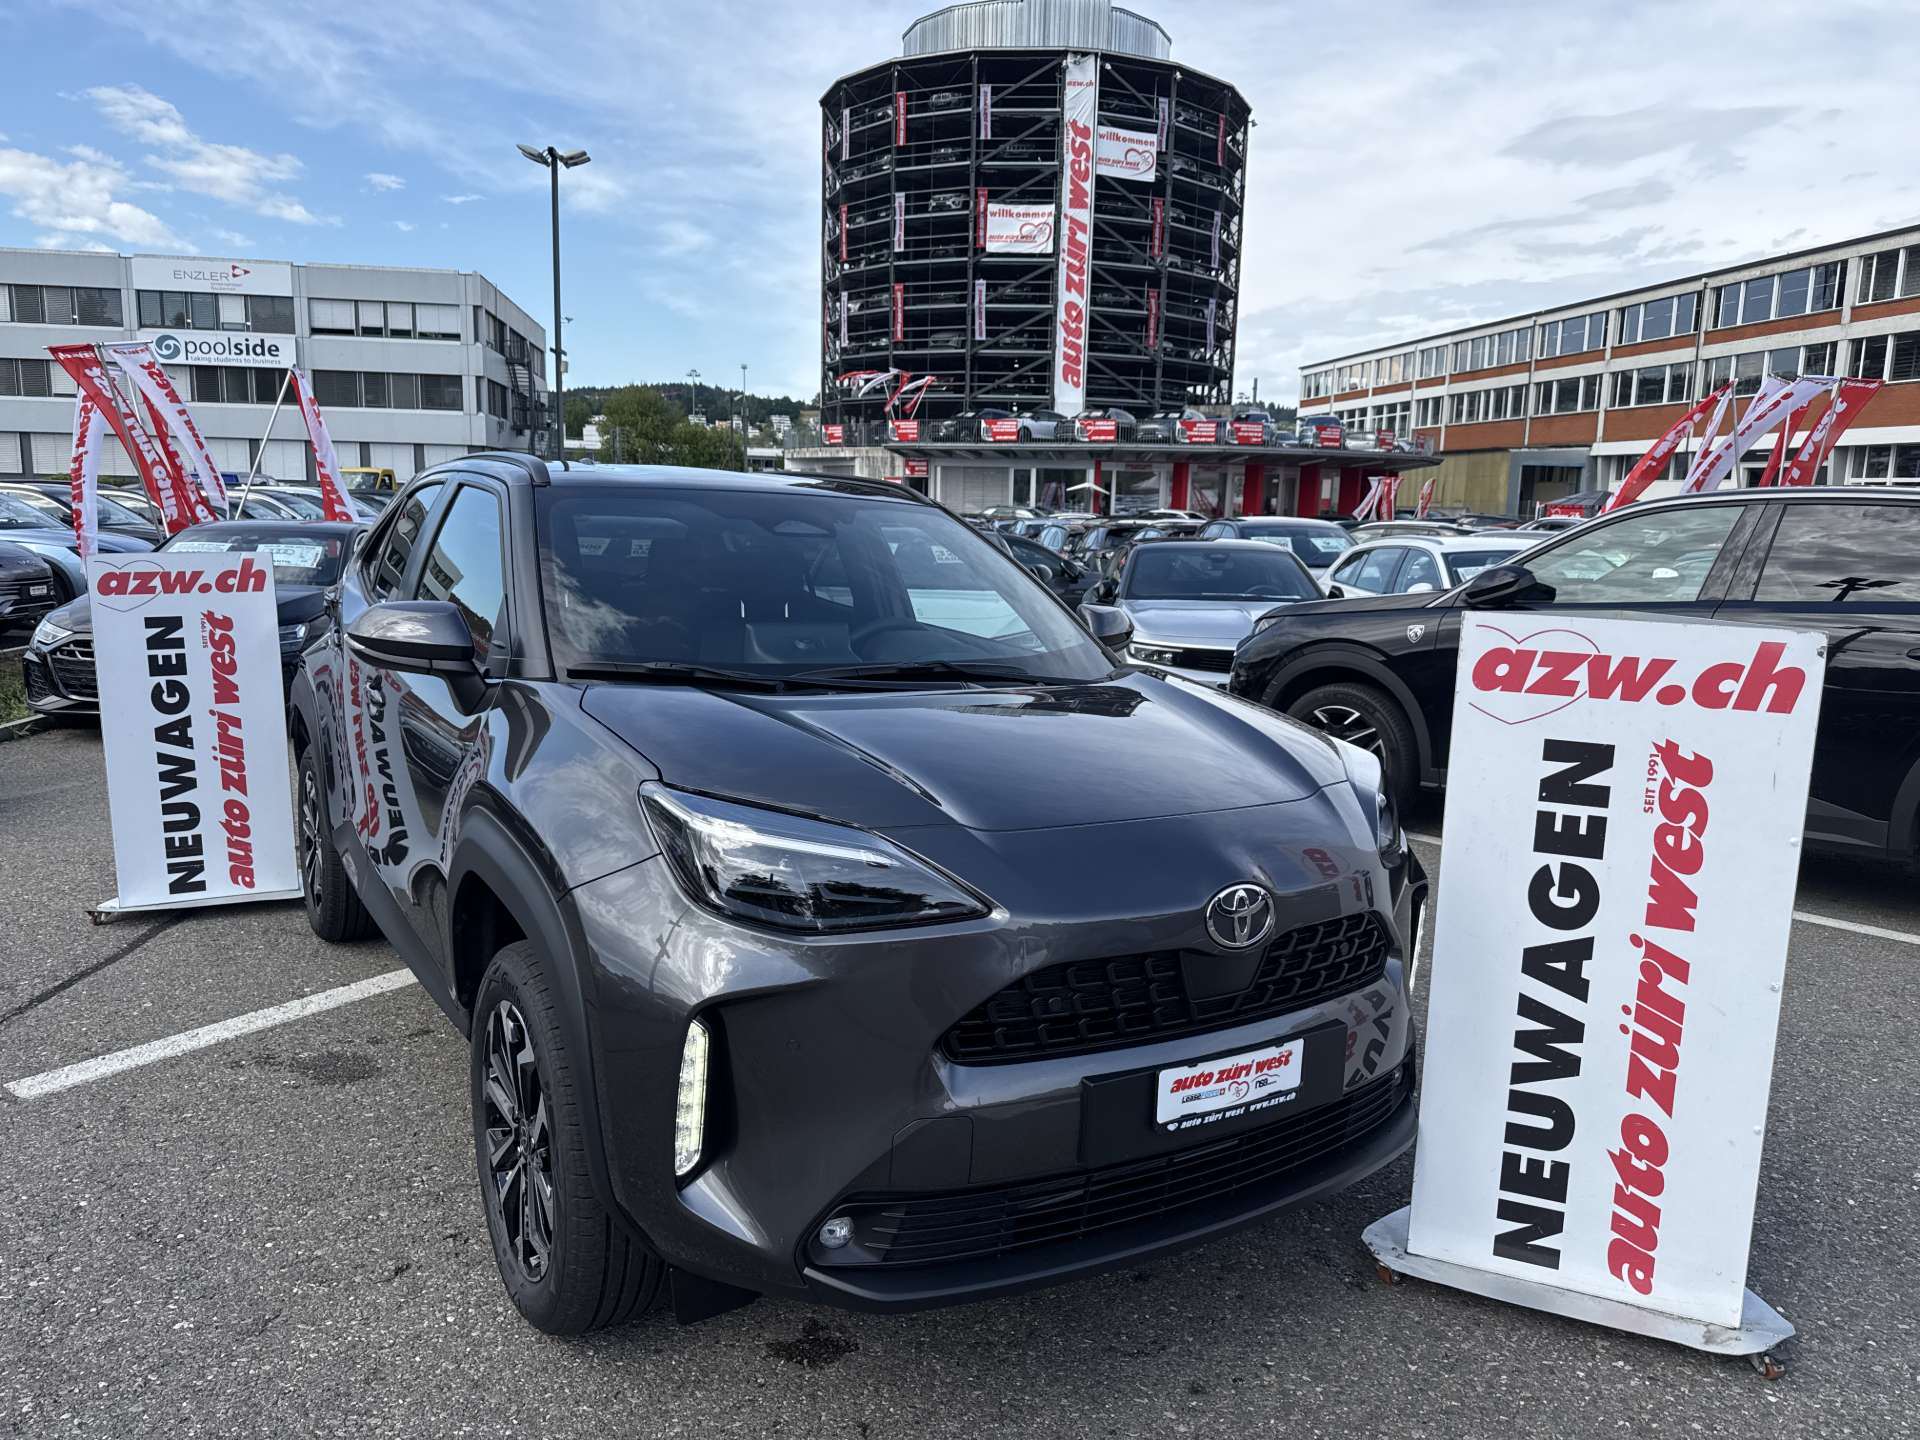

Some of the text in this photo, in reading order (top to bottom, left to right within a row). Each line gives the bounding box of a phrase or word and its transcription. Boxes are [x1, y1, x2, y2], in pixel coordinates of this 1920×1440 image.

[1098, 133, 1156, 147] willkommen
[988, 208, 1055, 219] willkommen
[173, 270, 230, 281] ENZLER
[1060, 118, 1092, 388] auto züri west
[184, 337, 280, 360] poolside
[97, 558, 267, 597] azw.ch
[1472, 641, 1806, 714] azw.ch
[144, 616, 207, 895] NEUWAGEN
[200, 609, 256, 889] auto züri west
[1643, 753, 1660, 815] SEIT 1991
[1493, 738, 1616, 1270] NEUWAGEN
[1606, 738, 1714, 1296] auto züri west
[1170, 1053, 1293, 1093] auto züri west
[1180, 1117, 1202, 1129] auto
[1203, 1112, 1223, 1124] züri
[1224, 1107, 1246, 1119] west
